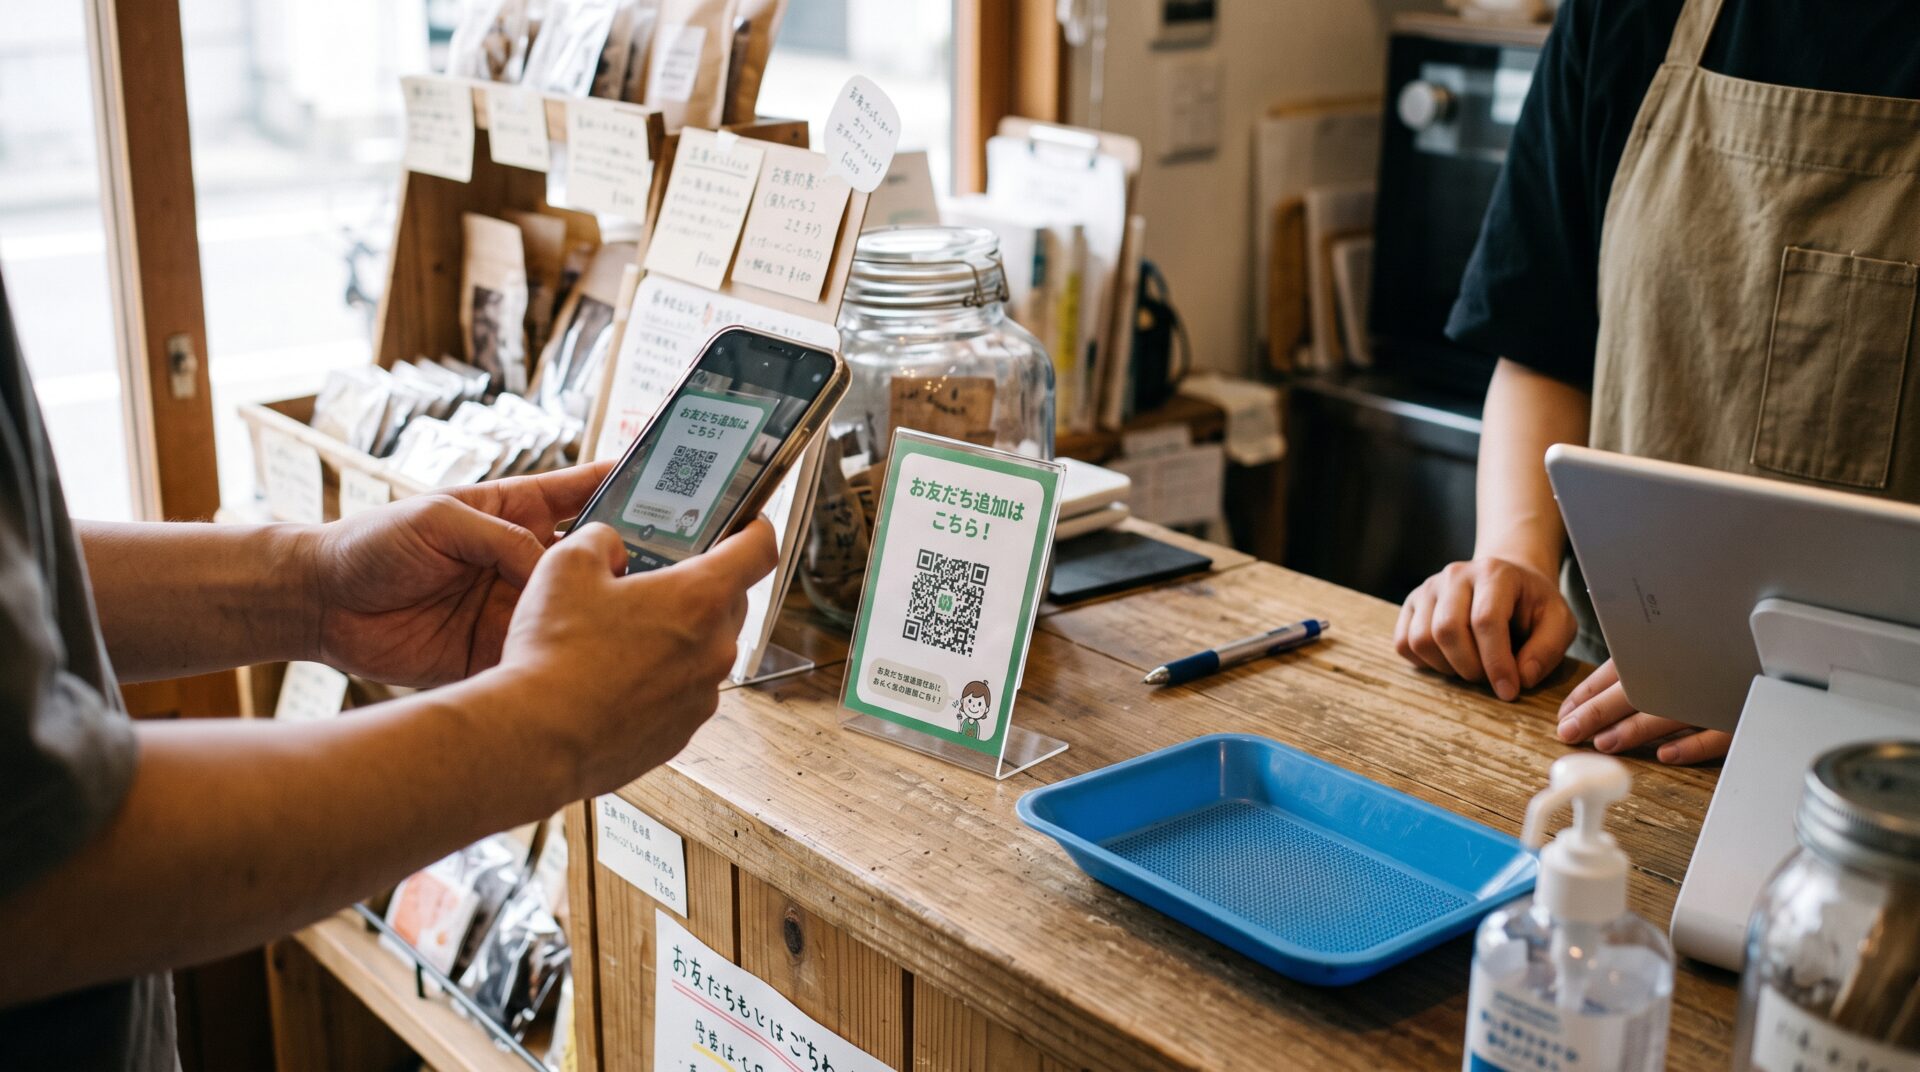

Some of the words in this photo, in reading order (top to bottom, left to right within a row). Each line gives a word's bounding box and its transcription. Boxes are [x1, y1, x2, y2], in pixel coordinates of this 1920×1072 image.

[680, 407, 749, 430] お友だち追加は
[688, 424, 724, 440] こちら！
[910, 477, 1025, 521] お友だち追加は
[933, 511, 990, 540] こちら！
